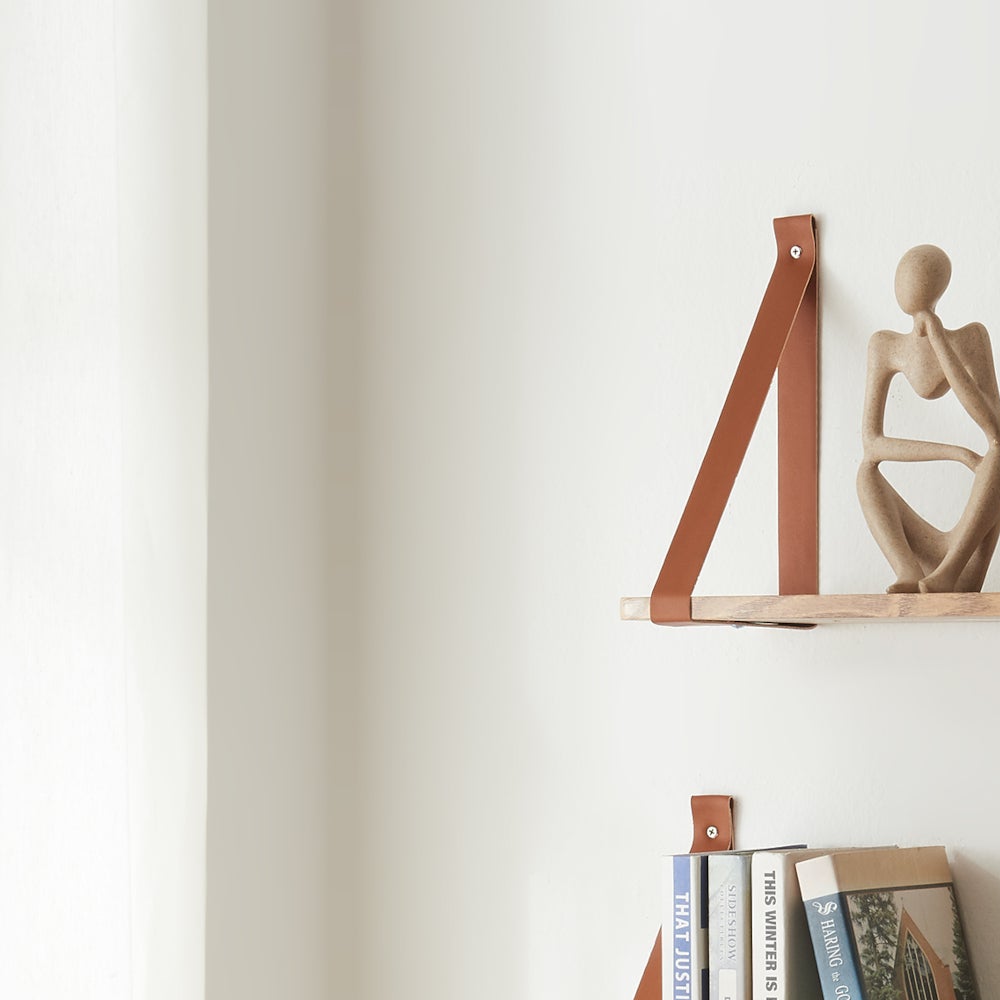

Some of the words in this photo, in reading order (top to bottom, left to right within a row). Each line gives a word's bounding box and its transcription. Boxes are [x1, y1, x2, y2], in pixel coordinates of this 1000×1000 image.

[764, 870, 776, 905] THIS
[675, 892, 690, 942] THAT
[728, 884, 736, 961] SIDESHOW
[765, 910, 777, 971] WINTER
[766, 977, 777, 991] IS
[831, 971, 840, 982] the
